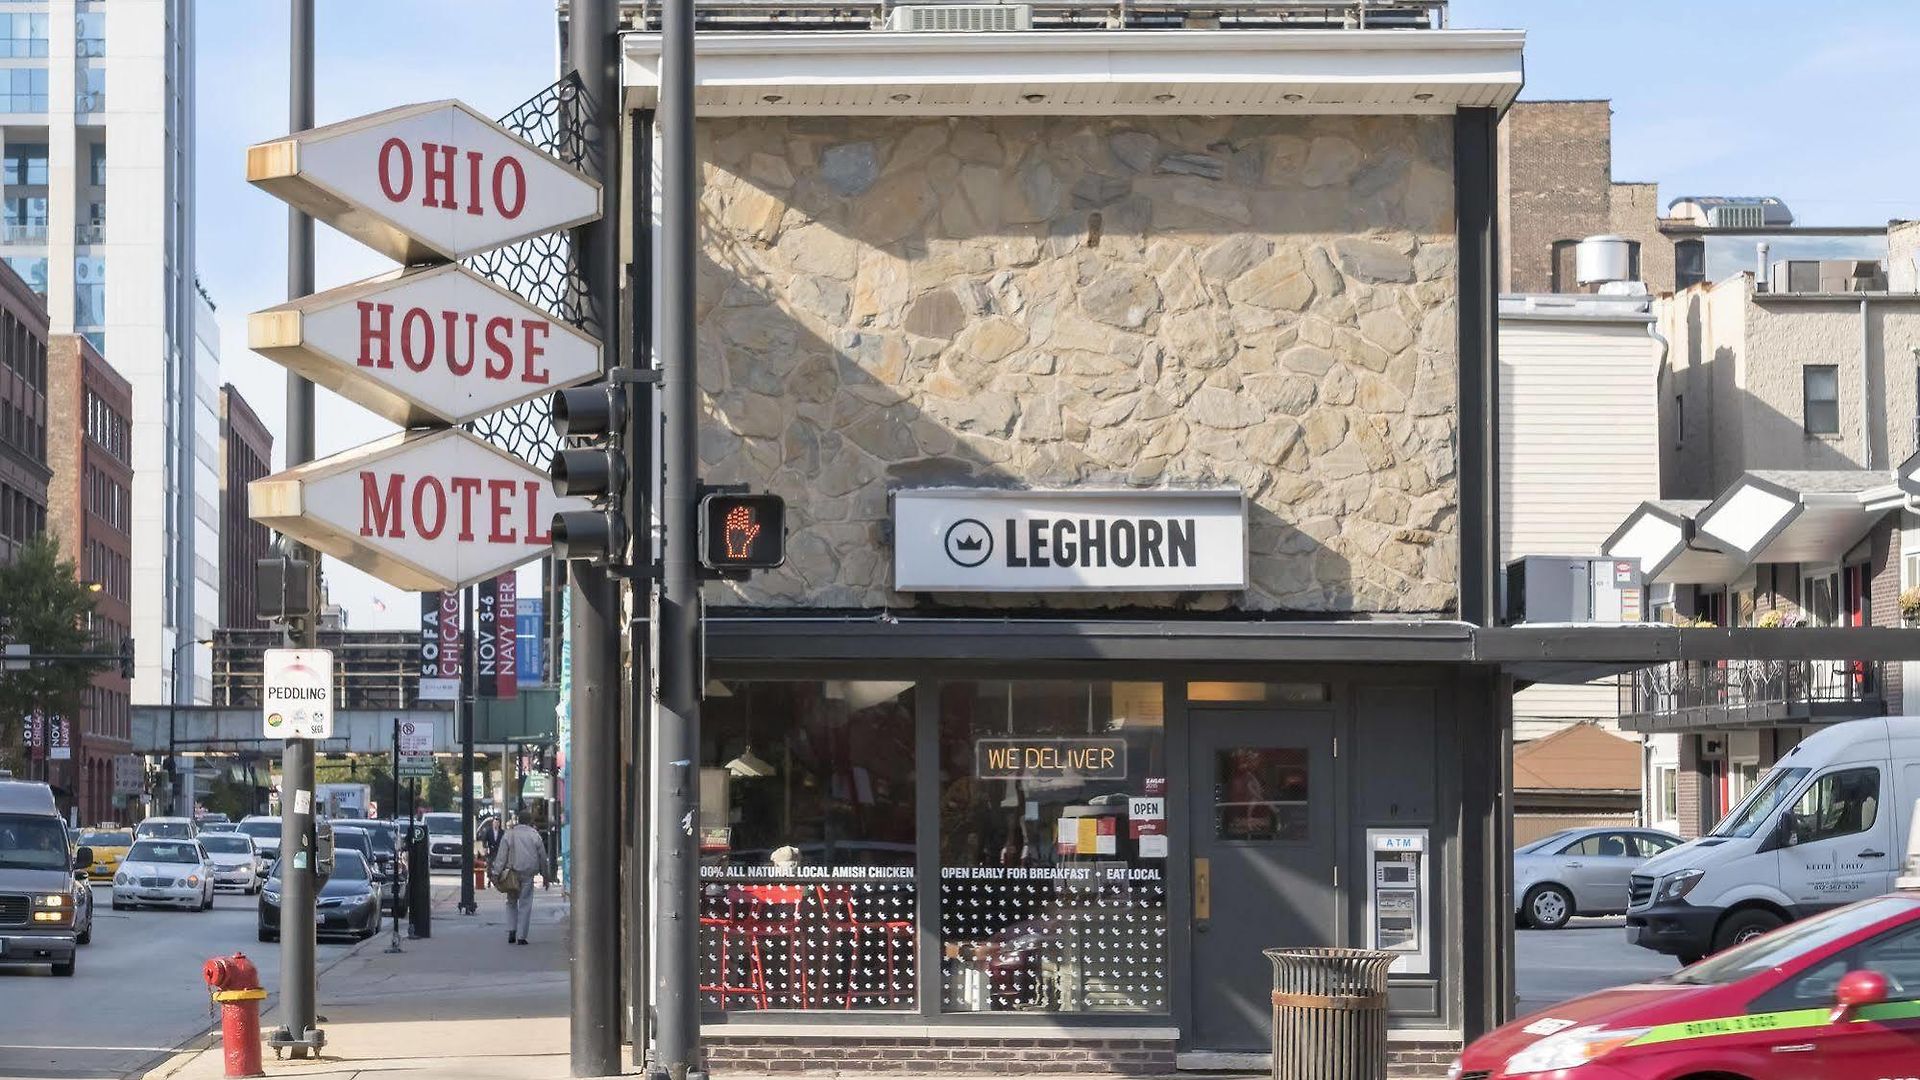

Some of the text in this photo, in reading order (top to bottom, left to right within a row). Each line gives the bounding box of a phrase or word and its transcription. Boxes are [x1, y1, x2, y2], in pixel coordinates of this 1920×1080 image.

[378, 137, 527, 220] OHIO
[357, 301, 550, 385] HOUSE
[360, 471, 552, 545] MOTEL
[1006, 518, 1197, 568] LEGHORN
[422, 610, 439, 676] SOFA
[480, 595, 496, 675] NOV 3-6
[500, 582, 515, 675] NAVY PIER
[268, 687, 326, 700] PEDDLING
[988, 748, 1115, 769] WE DELIVER
[1134, 803, 1158, 815] OPEN
[1386, 839, 1411, 847] ATM
[700, 866, 914, 878] 00% ALL NATURAL LOCAL AMISH CHICKEN
[941, 867, 1161, 880] OPEN EARLY FOR BREAKFAST EAT LOCAL
